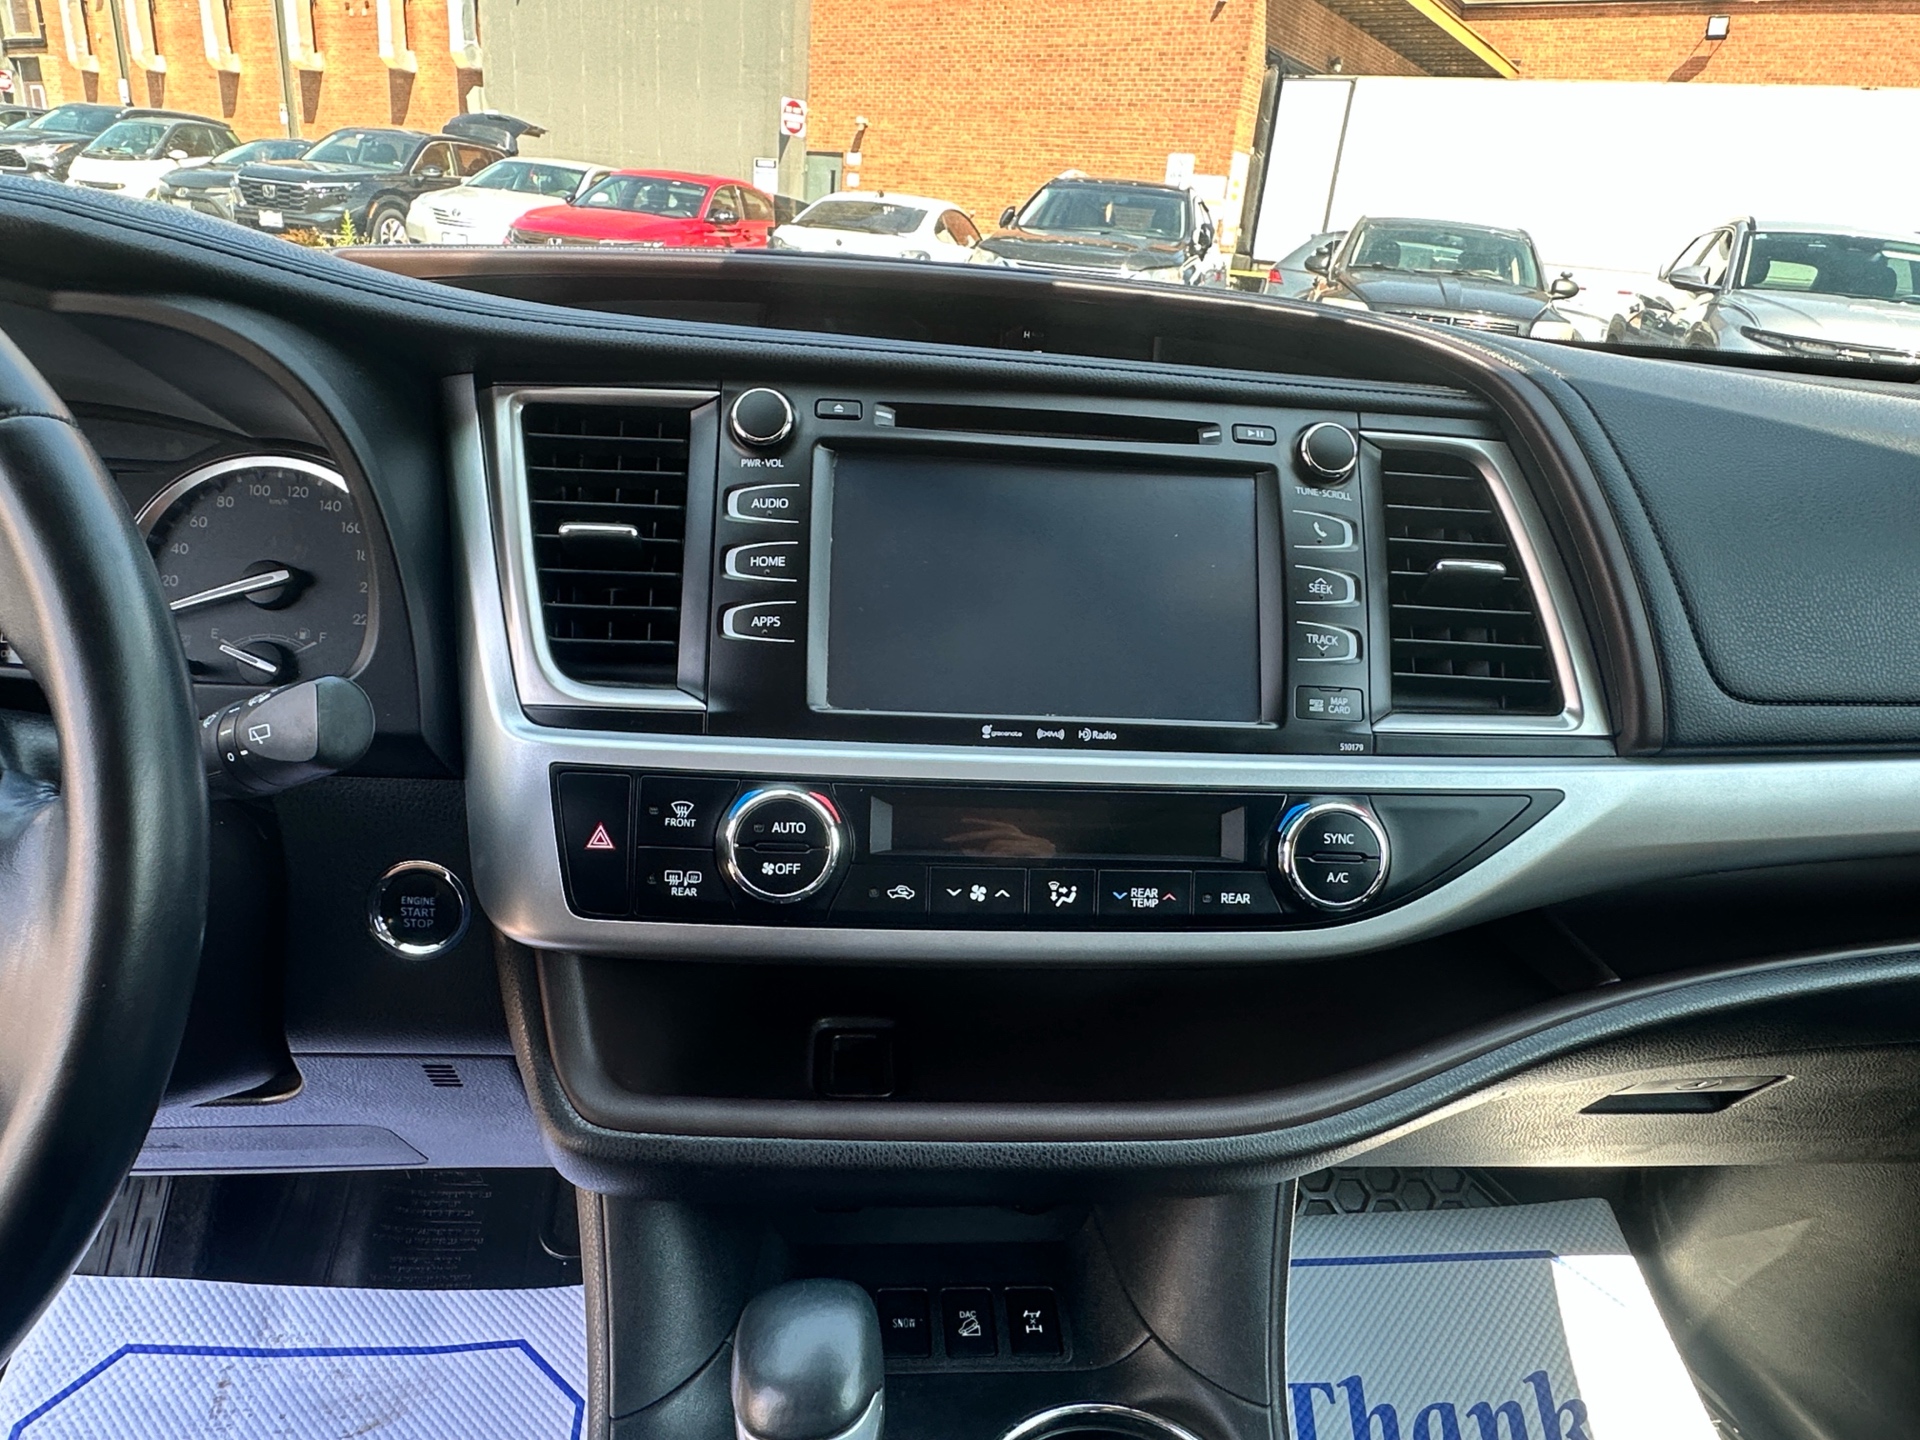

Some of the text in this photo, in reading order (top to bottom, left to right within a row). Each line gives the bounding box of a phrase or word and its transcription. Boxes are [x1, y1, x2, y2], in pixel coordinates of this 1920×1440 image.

[249, 485, 271, 496] 100
[287, 486, 309, 498] 120
[216, 496, 234, 508] 80
[320, 500, 342, 512] 140
[751, 498, 789, 509] AUDIO
[190, 516, 208, 528] 60
[170, 543, 189, 554] 40
[750, 556, 786, 567] HOME
[162, 575, 179, 587] 20
[1308, 583, 1333, 594] SEEK
[751, 616, 781, 627] APPS
[211, 628, 219, 638] E
[319, 632, 327, 643] F
[1306, 634, 1338, 646] TRACK
[1330, 696, 1349, 706] MAP
[1328, 705, 1351, 714] CARD
[1092, 730, 1117, 740] Radio
[1340, 743, 1364, 751] 510179
[665, 818, 696, 828] FRONT
[771, 822, 807, 834] AUTO
[1323, 833, 1355, 845] SYNC
[775, 863, 801, 875] OFF
[1326, 871, 1350, 883] A/C
[671, 887, 698, 897] REAR
[1130, 888, 1159, 898] REAR
[401, 896, 436, 906] ENGINE
[1131, 898, 1159, 908] TEMP
[1220, 893, 1251, 904] REAR
[400, 907, 436, 918] START
[403, 918, 434, 929] STOP
[958, 1310, 977, 1320] DAC
[1288, 1370, 1593, 1440] Thank
